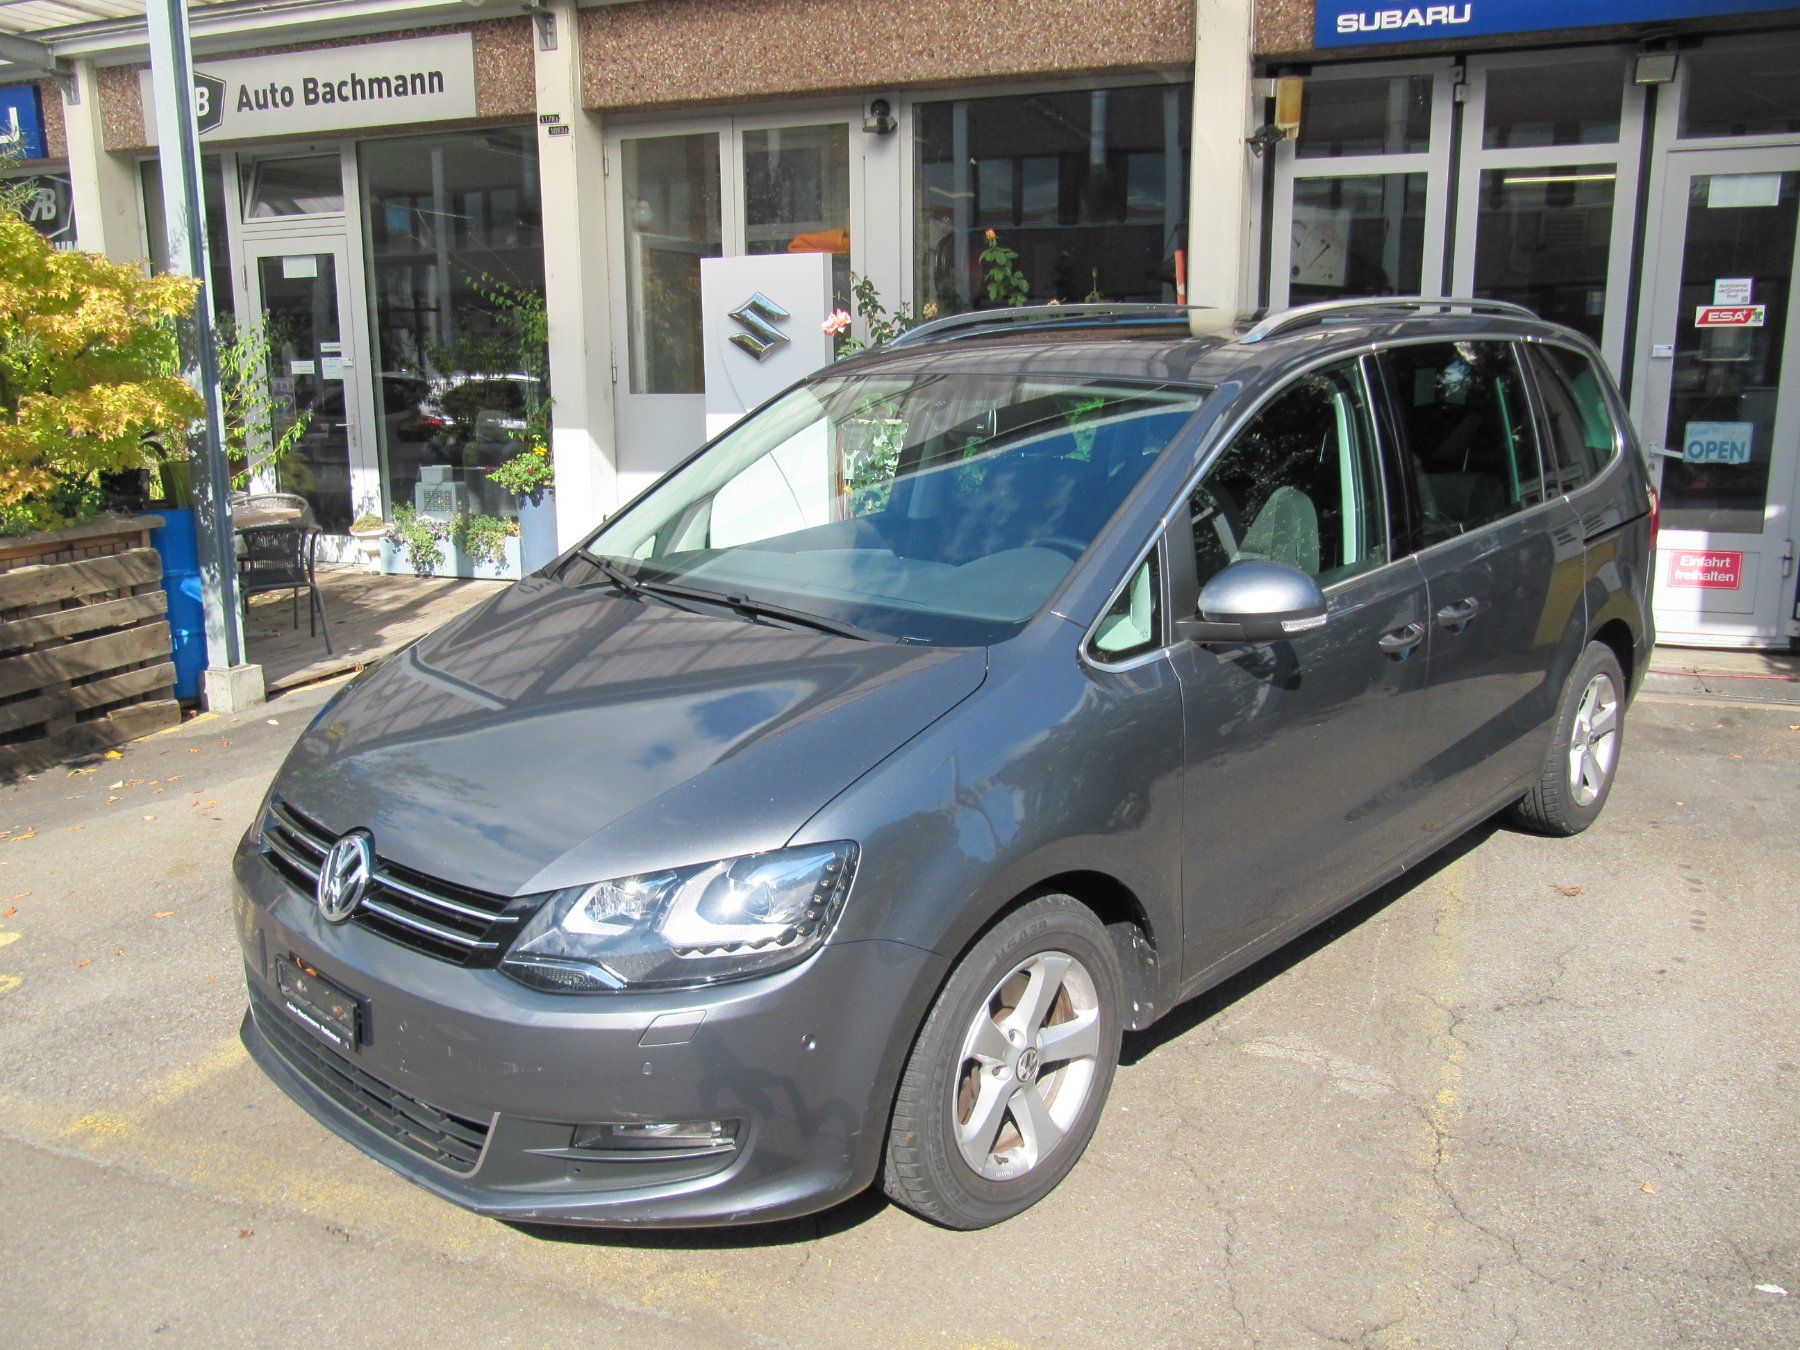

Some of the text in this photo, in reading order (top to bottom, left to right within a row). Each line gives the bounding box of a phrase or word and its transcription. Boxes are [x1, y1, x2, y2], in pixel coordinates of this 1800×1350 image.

[1336, 3, 1471, 33] SUBARU
[195, 86, 210, 117] B
[236, 70, 444, 113] Auto Bachmann
[1687, 440, 1746, 460] OPEN
[1680, 555, 1731, 568] Einfahrt
[1675, 569, 1735, 582] freihalten
